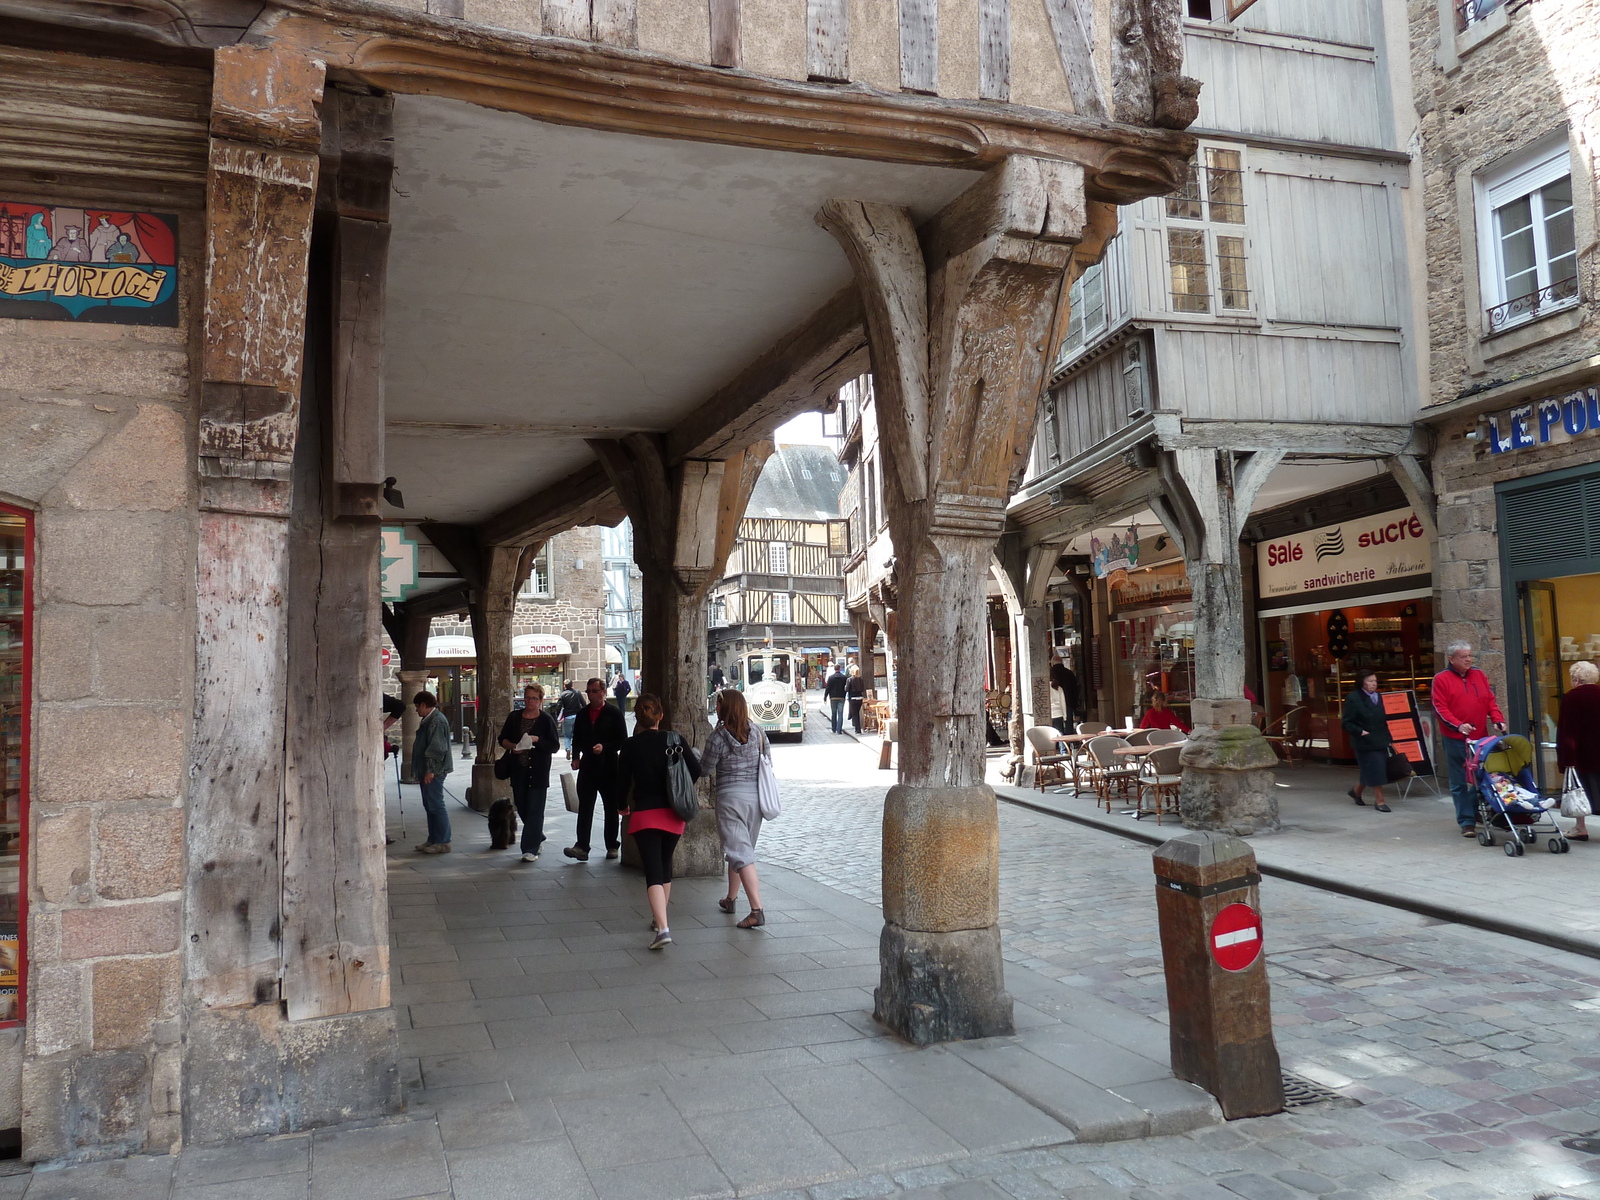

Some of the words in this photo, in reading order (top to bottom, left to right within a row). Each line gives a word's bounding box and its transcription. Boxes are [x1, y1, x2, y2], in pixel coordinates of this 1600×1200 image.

[18, 266, 158, 299] L'HORLOGE
[1489, 405, 1535, 454] LE
[1304, 567, 1375, 589] sandwicherie
[436, 647, 470, 655] Joailliers
